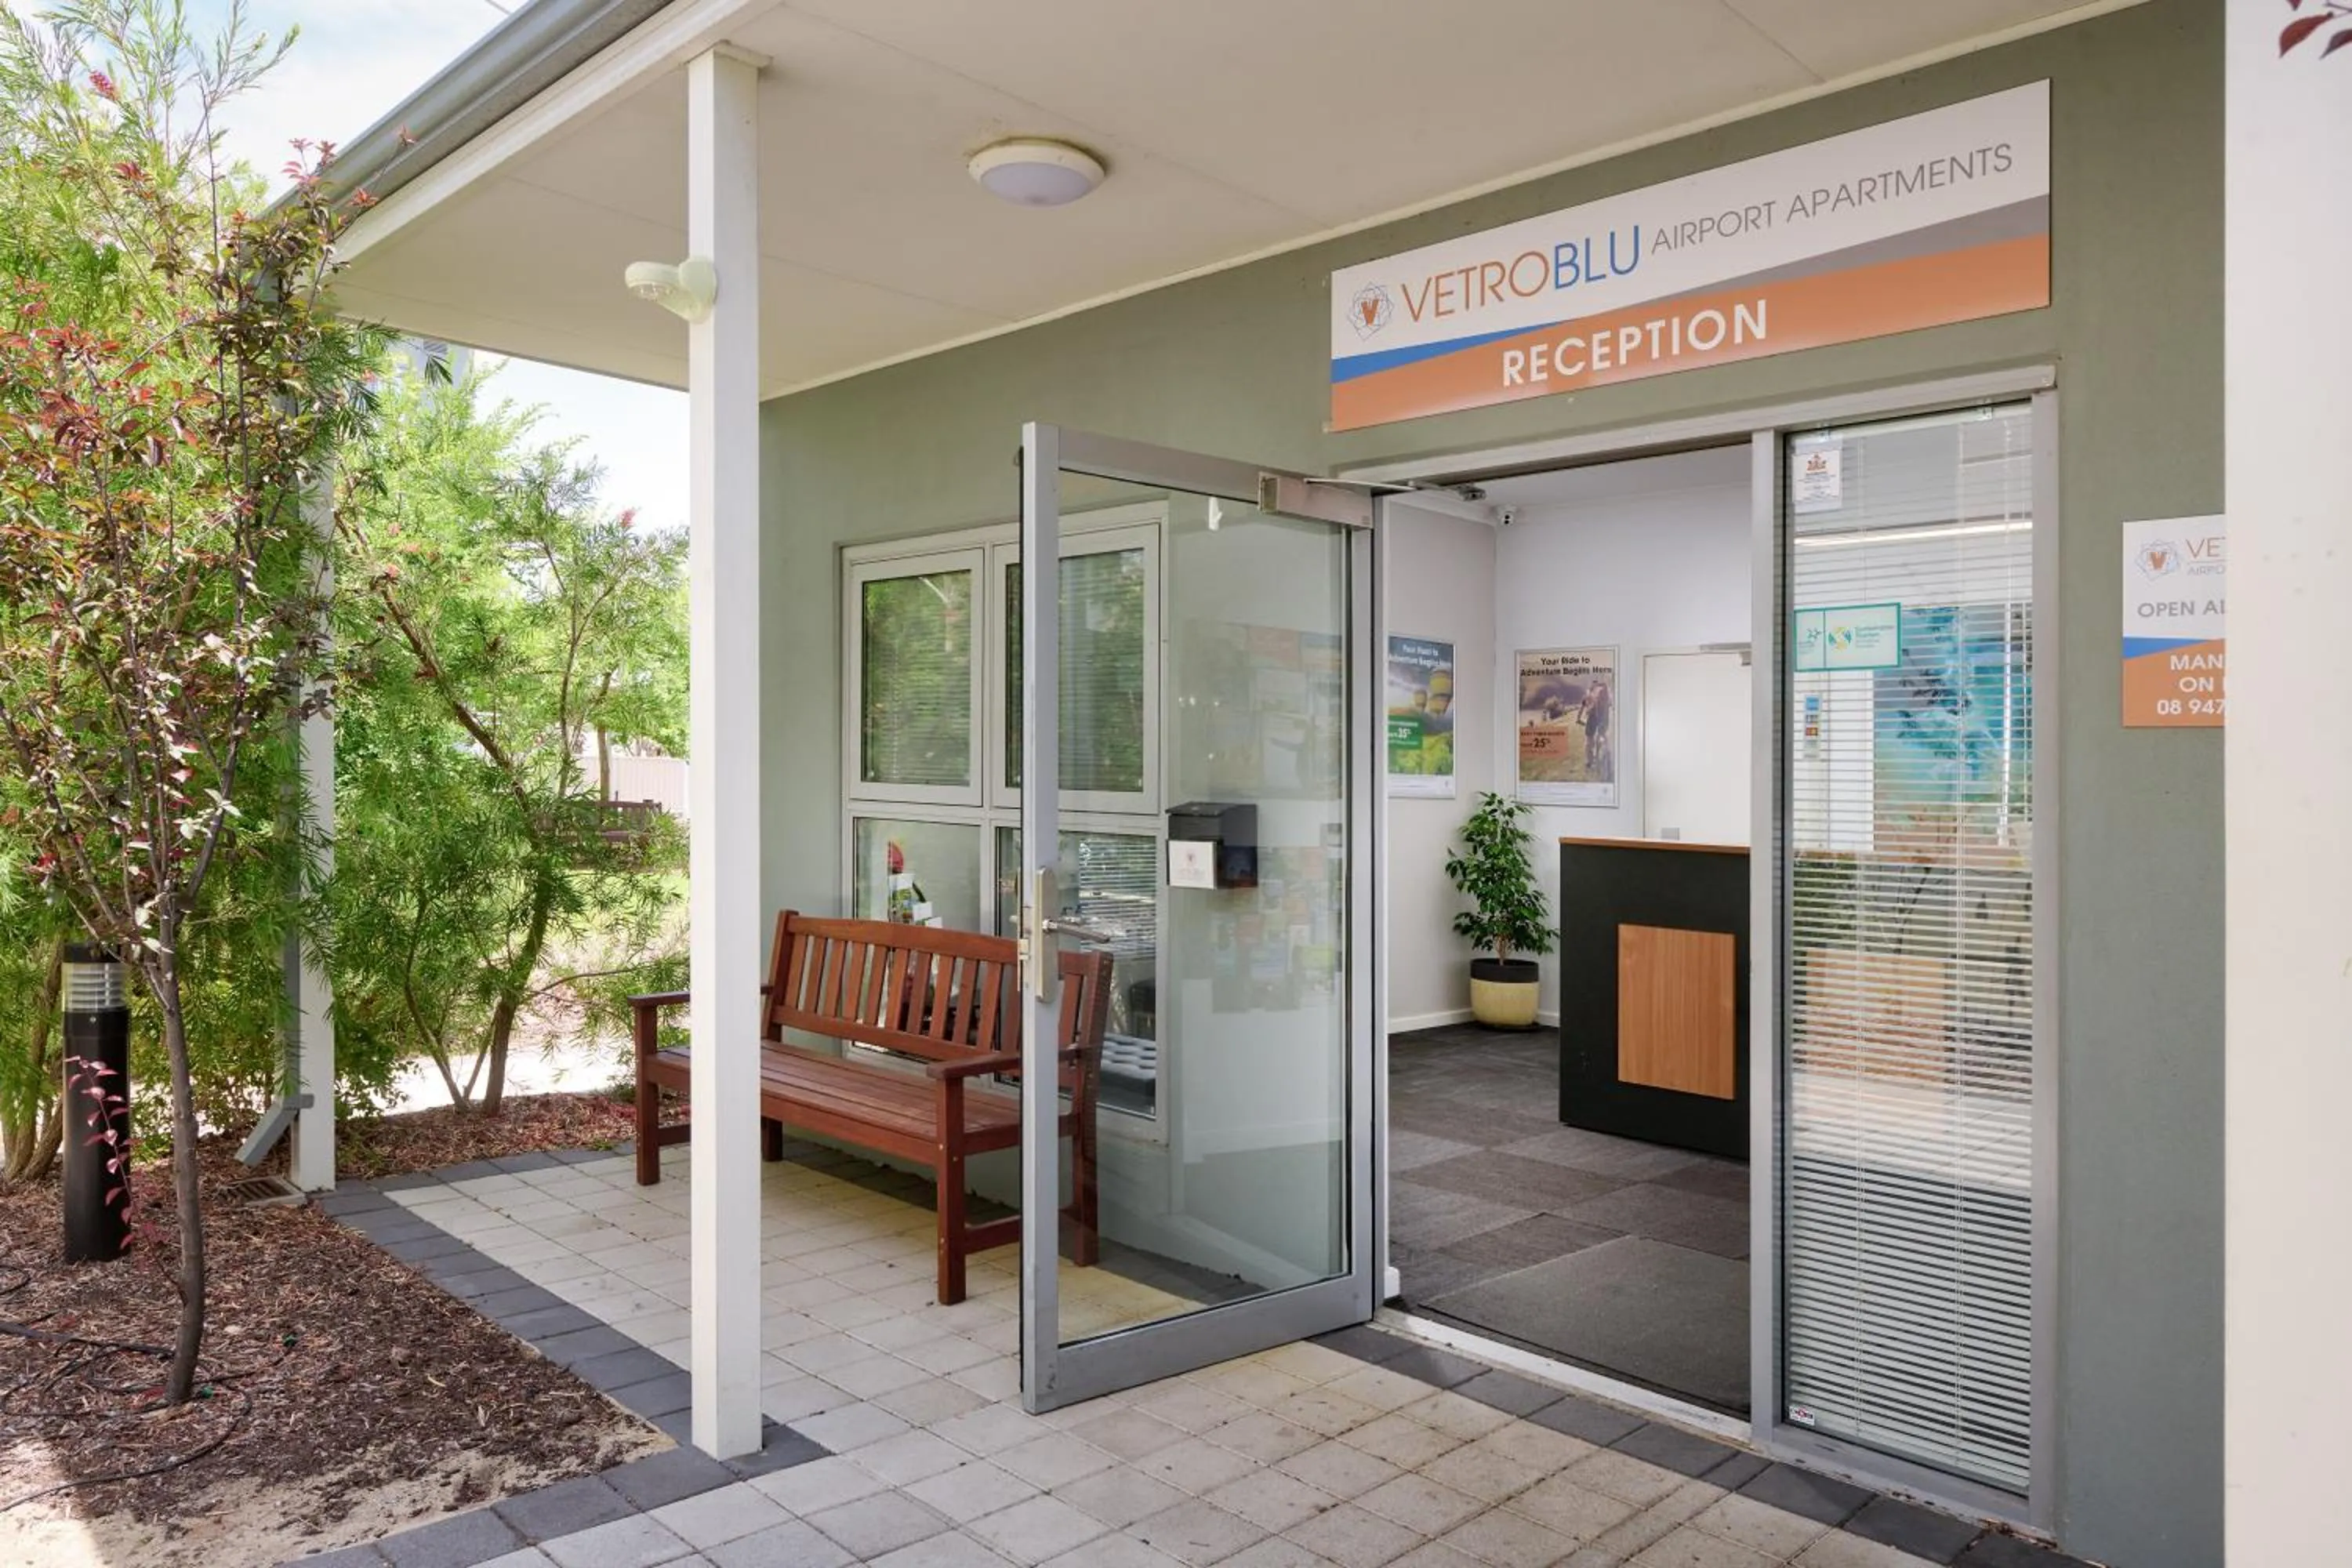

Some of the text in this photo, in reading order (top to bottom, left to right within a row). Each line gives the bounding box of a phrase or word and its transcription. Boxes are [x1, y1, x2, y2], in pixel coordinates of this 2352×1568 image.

[1401, 225, 1639, 322] VETROBLU
[1650, 201, 1776, 256] AIRPORT
[1786, 143, 2013, 223] APARTMENTS
[1502, 299, 1766, 387] RECEPTION
[2185, 537, 2225, 558] VE
[2137, 601, 2195, 618] OPEN
[1563, 666, 1590, 676] Begins
[2180, 677, 2214, 692] ON
[2157, 698, 2224, 715] 08 947
